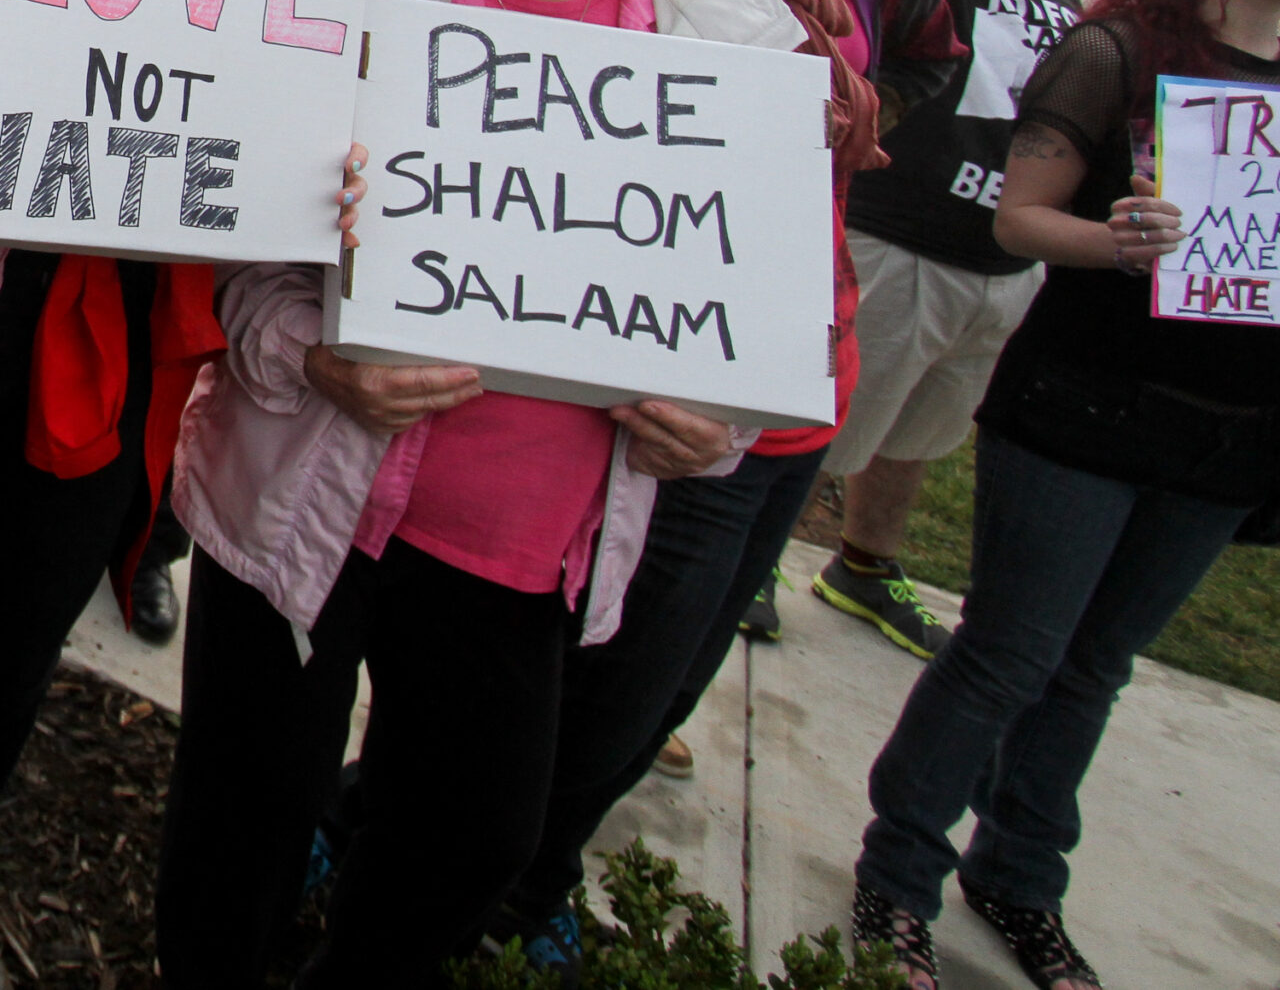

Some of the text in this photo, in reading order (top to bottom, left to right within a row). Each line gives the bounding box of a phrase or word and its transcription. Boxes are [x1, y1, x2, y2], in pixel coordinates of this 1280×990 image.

[84, 47, 215, 123] NOT
[426, 23, 726, 147] PEACE
[382, 150, 735, 265] SHALOM
[1239, 160, 1280, 198] 2
[394, 250, 737, 362] SALAAM
[1183, 273, 1271, 312] HATE
